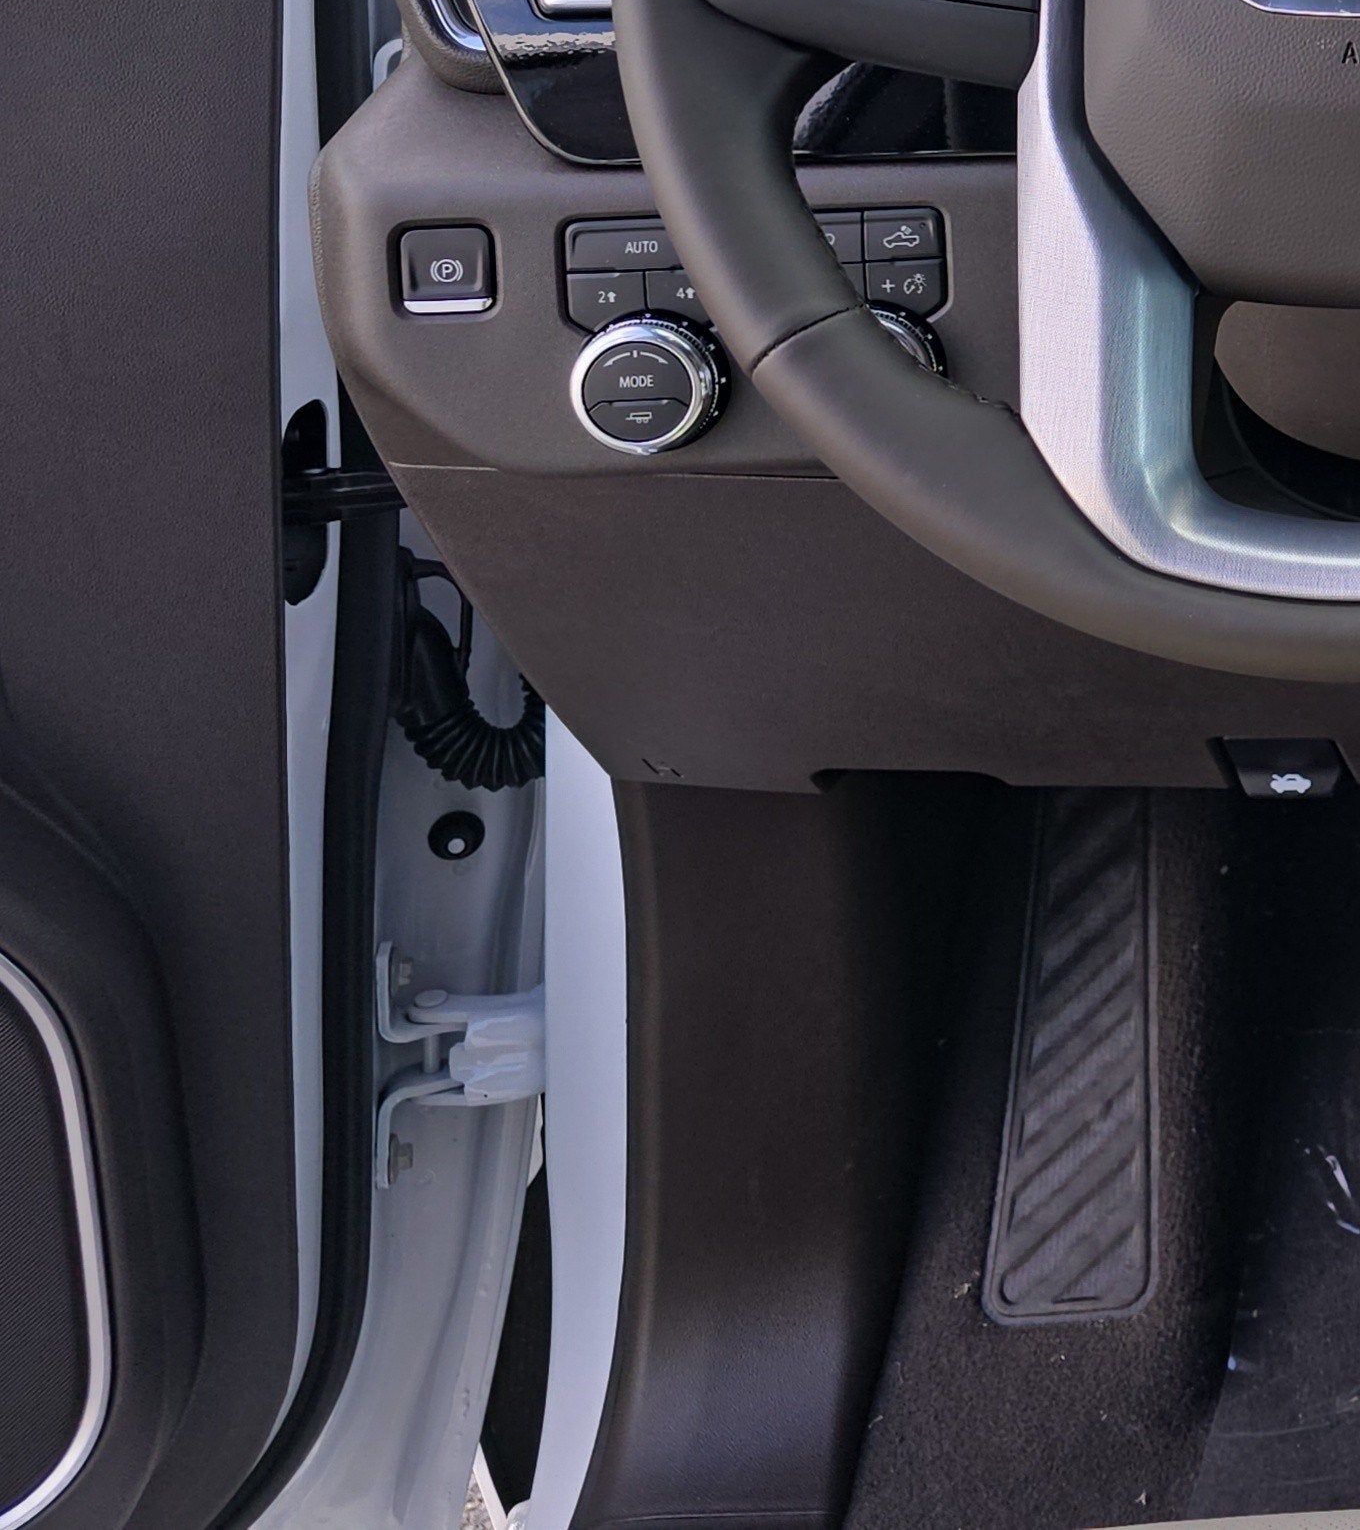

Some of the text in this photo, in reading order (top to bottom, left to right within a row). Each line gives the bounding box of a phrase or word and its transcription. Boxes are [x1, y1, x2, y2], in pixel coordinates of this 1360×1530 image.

[625, 241, 658, 254] AUTO
[598, 291, 606, 303] 2
[676, 287, 685, 299] 4
[619, 375, 654, 388] MODE
